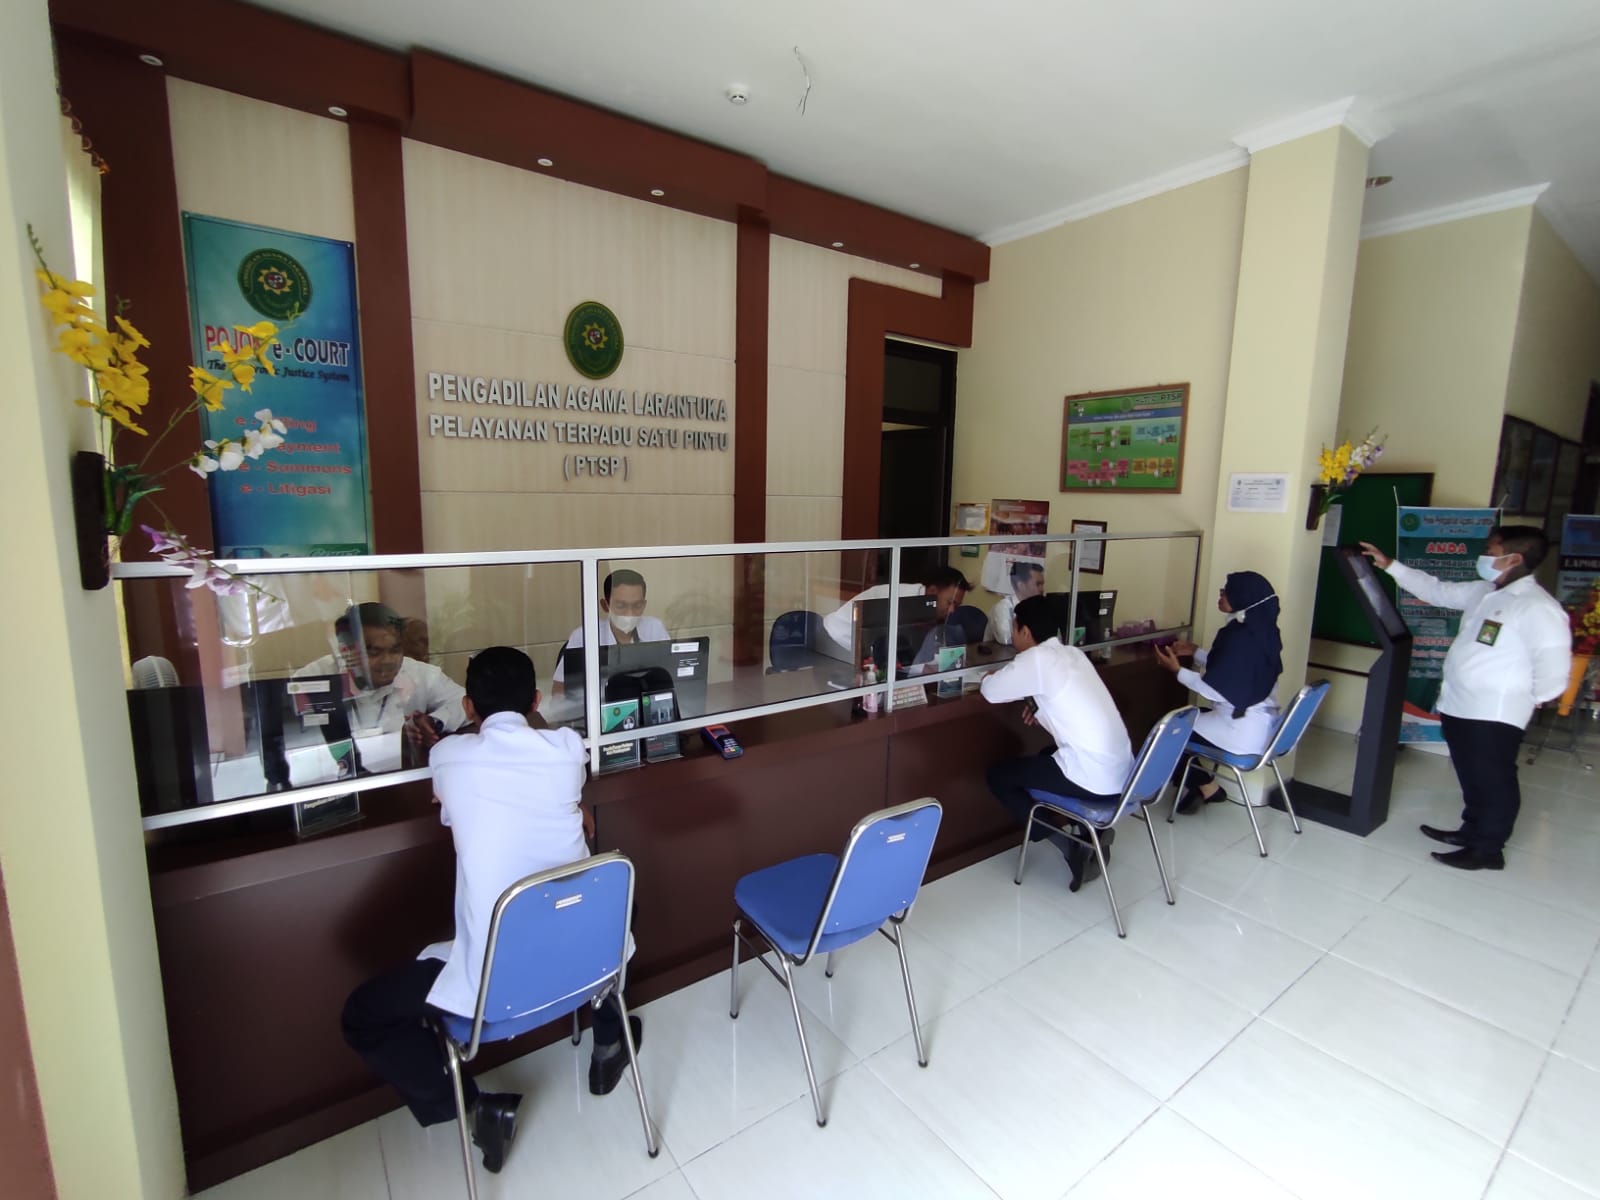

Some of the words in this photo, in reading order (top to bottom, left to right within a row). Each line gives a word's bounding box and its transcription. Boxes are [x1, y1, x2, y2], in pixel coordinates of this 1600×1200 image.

[293, 337, 350, 367] COURT
[207, 359, 226, 371] The
[428, 372, 560, 409] PENGADILAN
[565, 384, 628, 414] AGAMA
[633, 391, 728, 421] LARANTUKA
[429, 414, 549, 441] PELAYANAN
[554, 421, 633, 445] TERPADU
[638, 428, 681, 449] SATU
[683, 431, 729, 451] PINTU
[268, 442, 340, 454] ayment
[268, 482, 332, 497] Litigasi
[1425, 541, 1467, 554] ANDA
